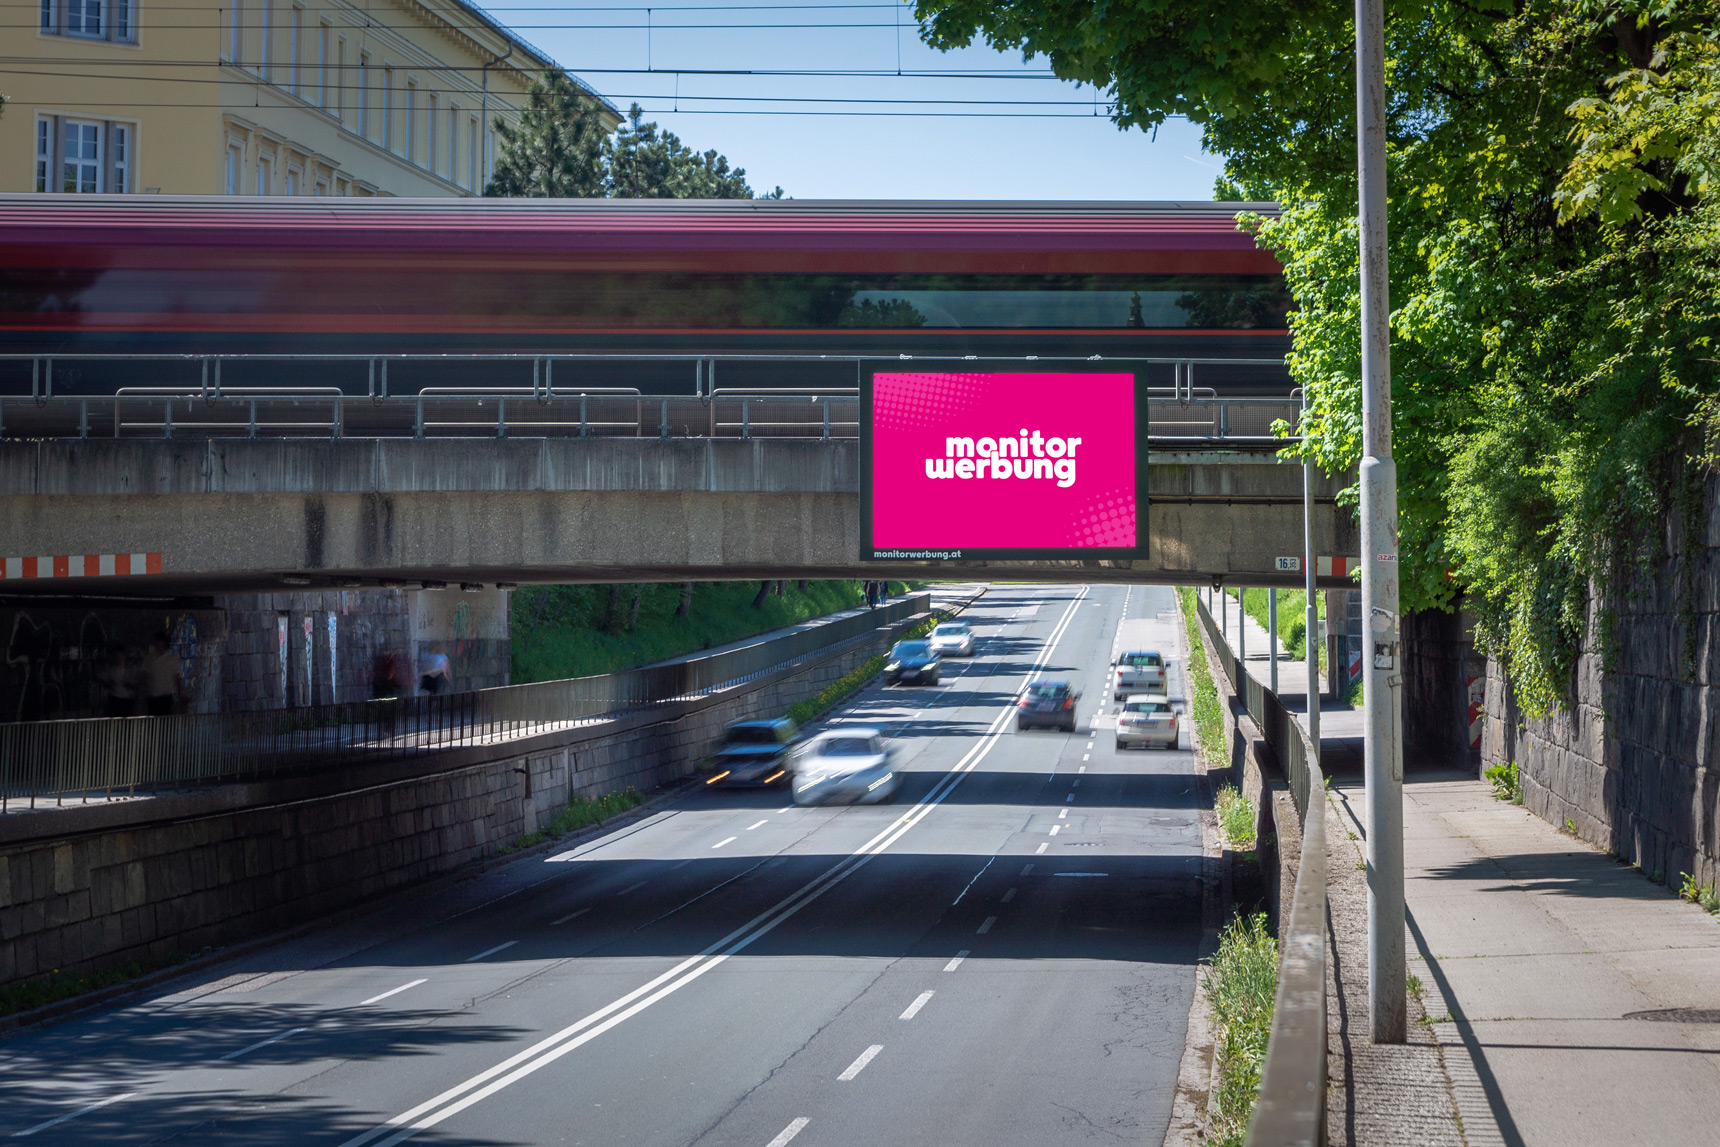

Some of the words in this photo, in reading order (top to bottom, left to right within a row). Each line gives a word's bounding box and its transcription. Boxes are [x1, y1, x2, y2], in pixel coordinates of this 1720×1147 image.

[945, 428, 1082, 458] monitor
[925, 450, 1076, 488] werbung
[873, 549, 962, 560] monitorwerbung.at
